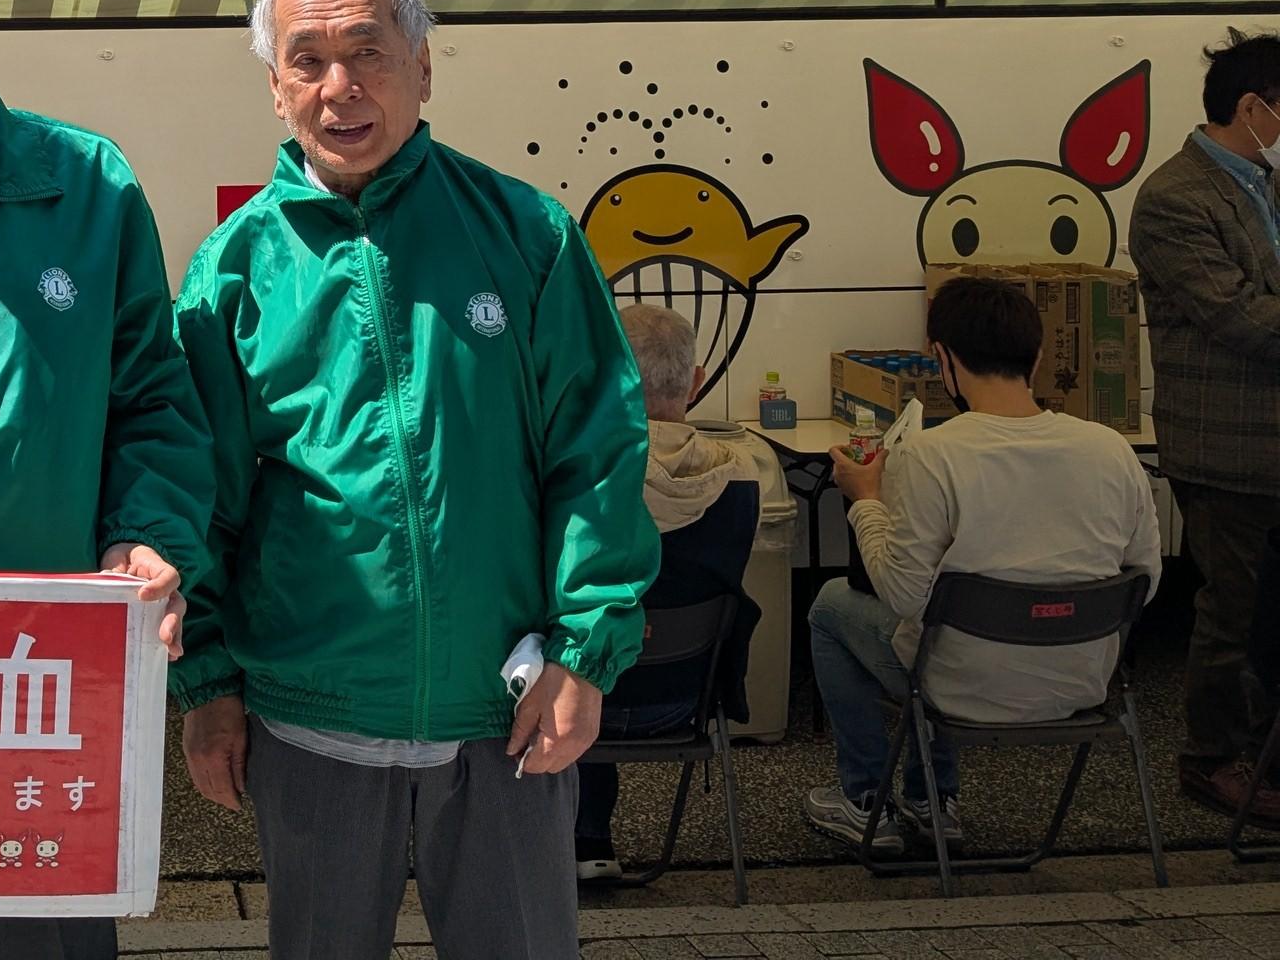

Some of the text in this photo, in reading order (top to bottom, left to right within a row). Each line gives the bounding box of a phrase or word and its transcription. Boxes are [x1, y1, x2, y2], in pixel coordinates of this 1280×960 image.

[54, 280, 64, 296] L
[472, 294, 499, 304] LIONS
[483, 306, 495, 321] L
[772, 408, 792, 422] JBL
